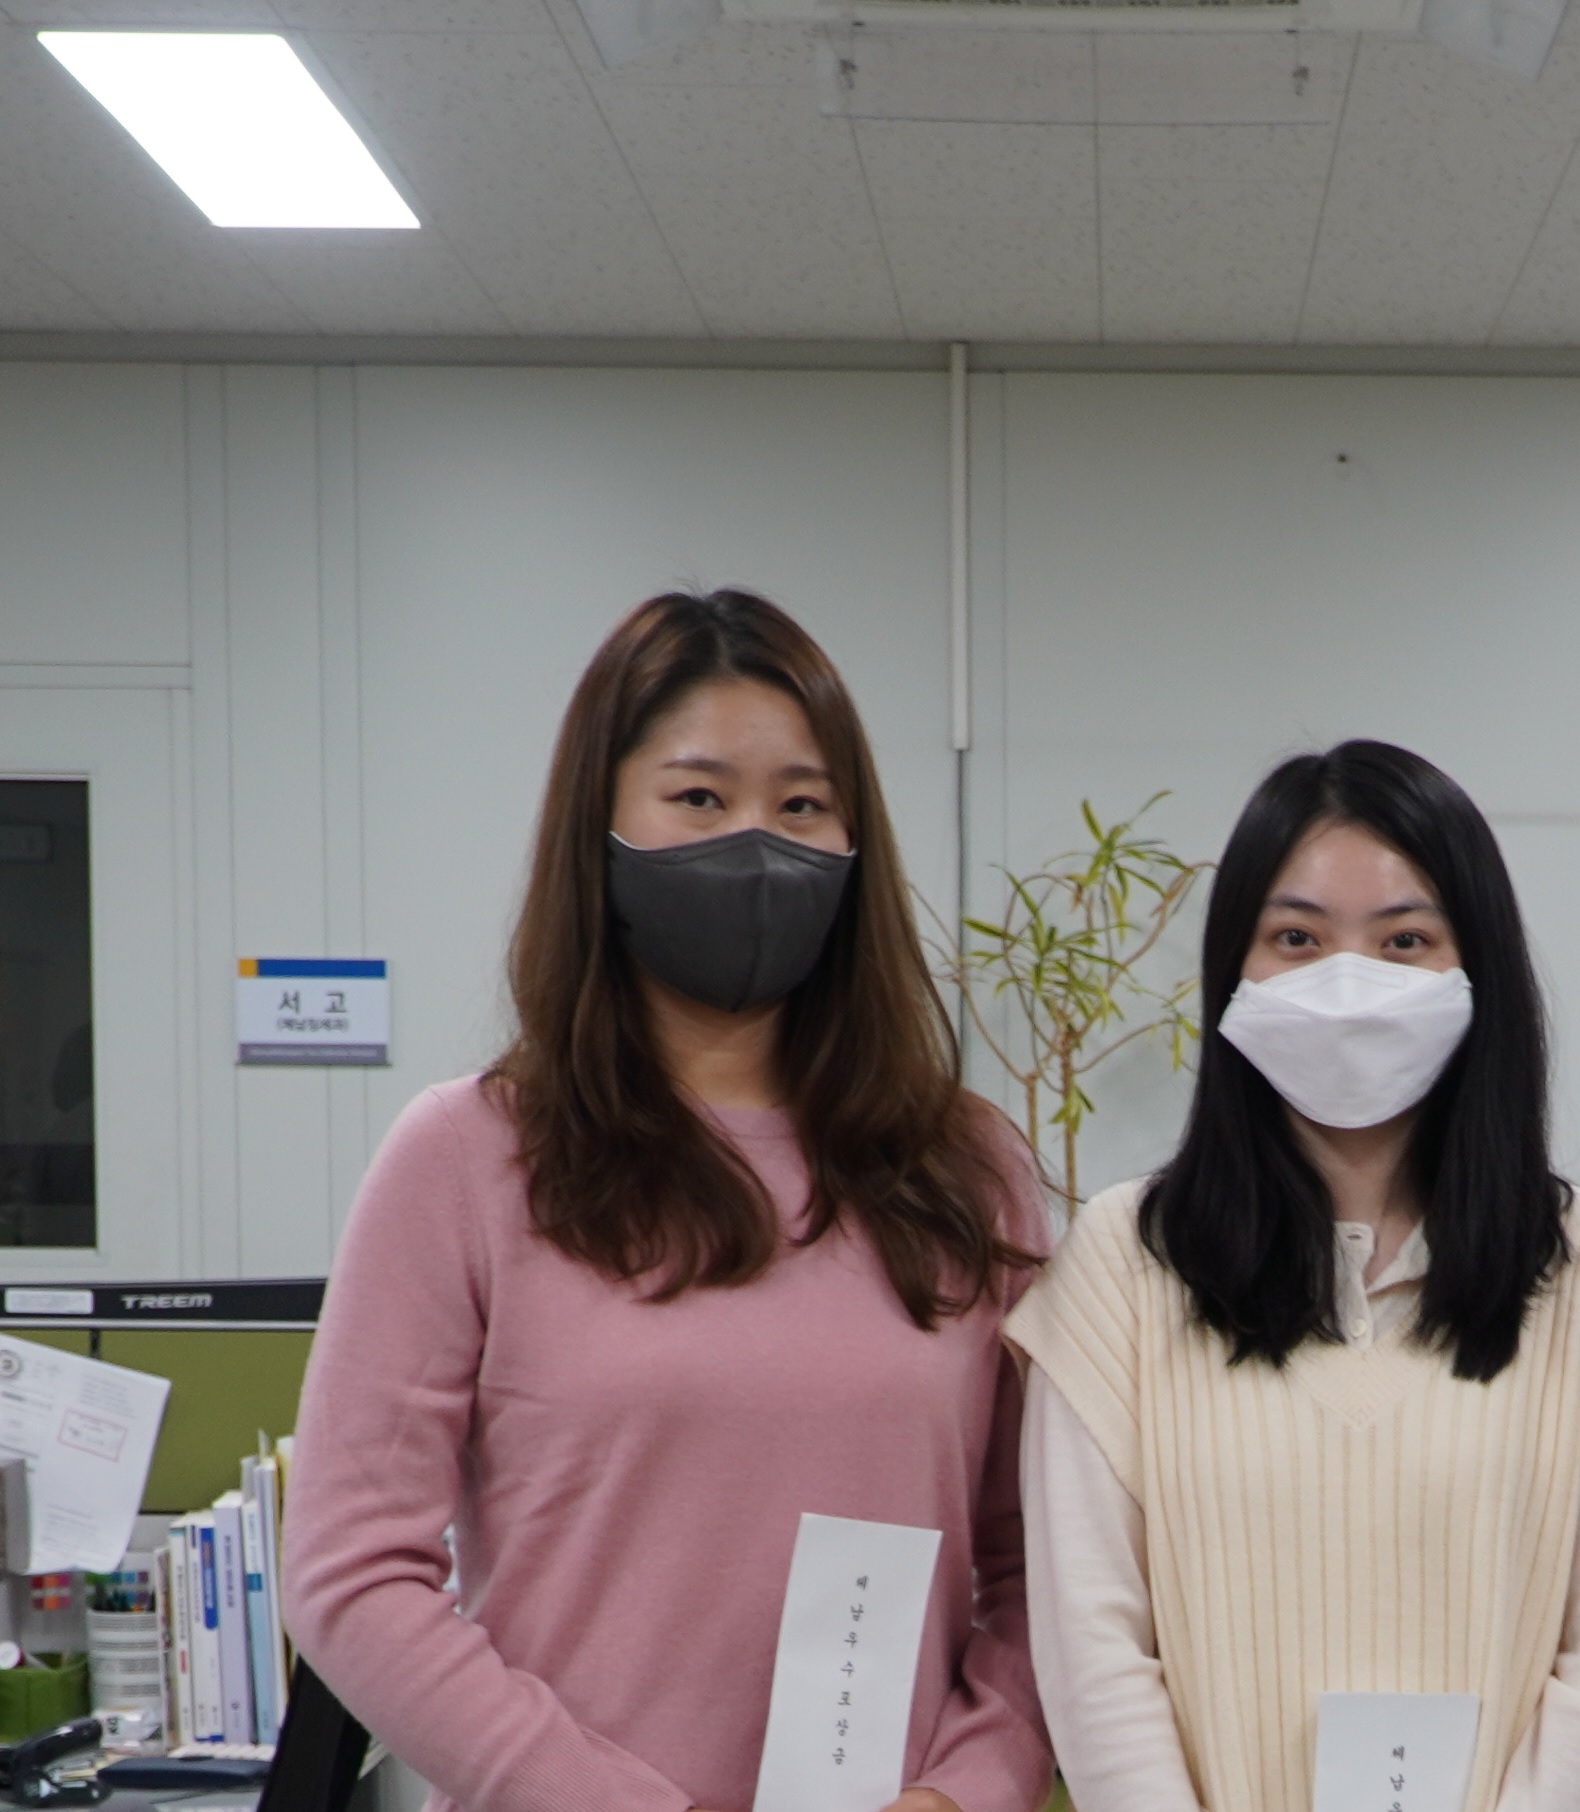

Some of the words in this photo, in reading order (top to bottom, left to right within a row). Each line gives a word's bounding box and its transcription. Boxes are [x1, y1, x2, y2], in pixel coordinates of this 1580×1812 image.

[279, 991, 301, 1014] 서
[324, 991, 347, 1013] 고
[121, 1293, 213, 1310] TREEM
